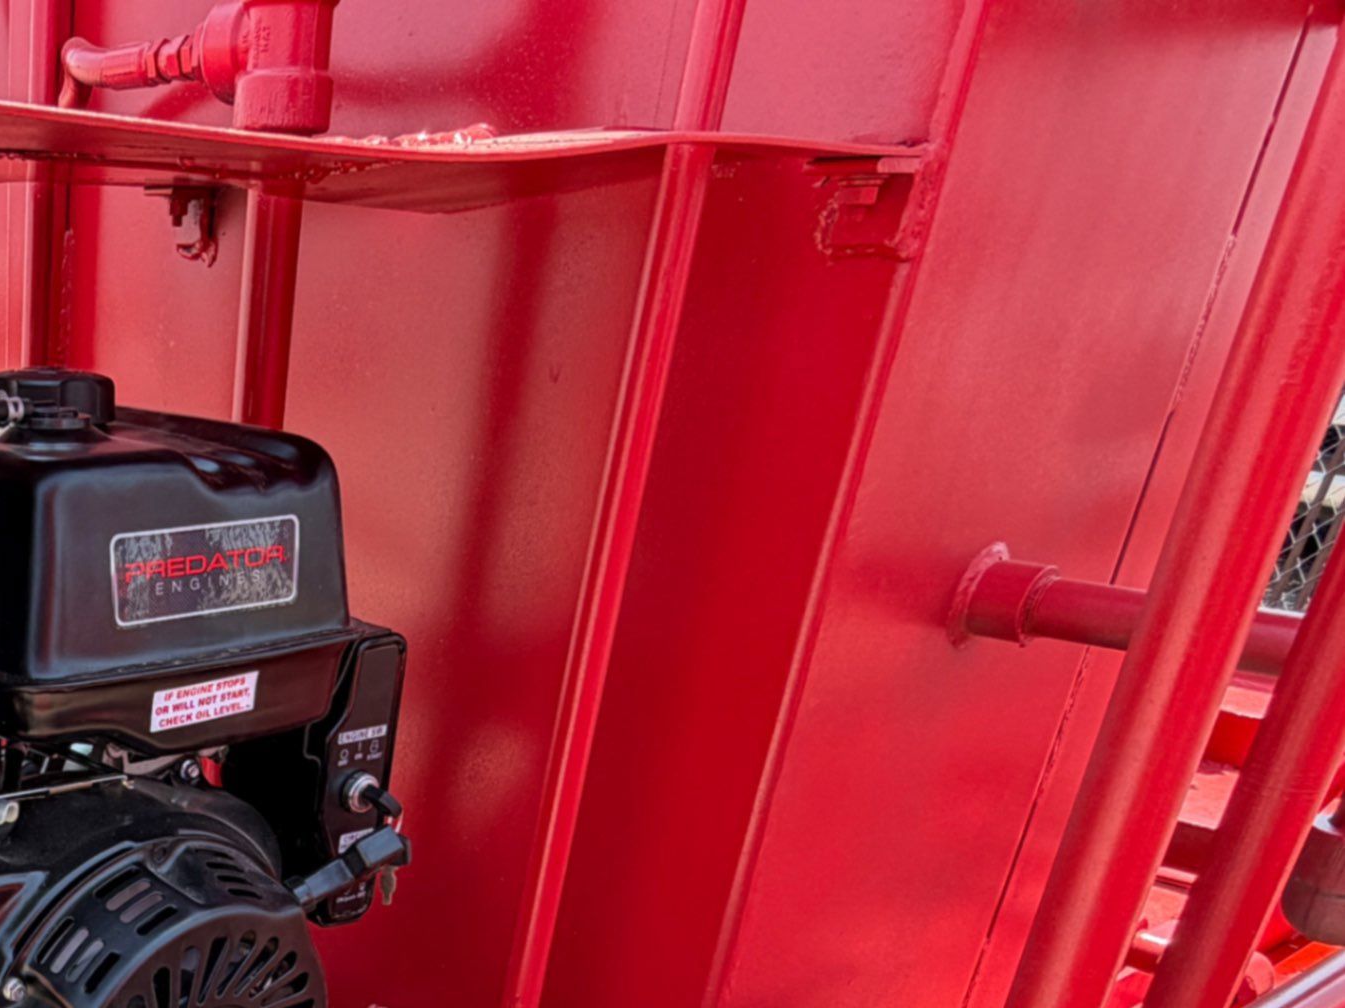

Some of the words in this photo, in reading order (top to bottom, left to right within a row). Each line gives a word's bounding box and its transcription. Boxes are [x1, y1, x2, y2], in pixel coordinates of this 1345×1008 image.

[125, 544, 286, 583] PREDATOR
[155, 569, 261, 596] ENGINES
[164, 692, 173, 702] IF
[176, 684, 214, 699] ENGINE
[216, 676, 246, 691] STOPS
[155, 706, 169, 716] OR
[172, 700, 195, 712] WILL
[197, 695, 217, 707] NOT
[158, 713, 193, 728] CHECK
[195, 709, 211, 720] OIL
